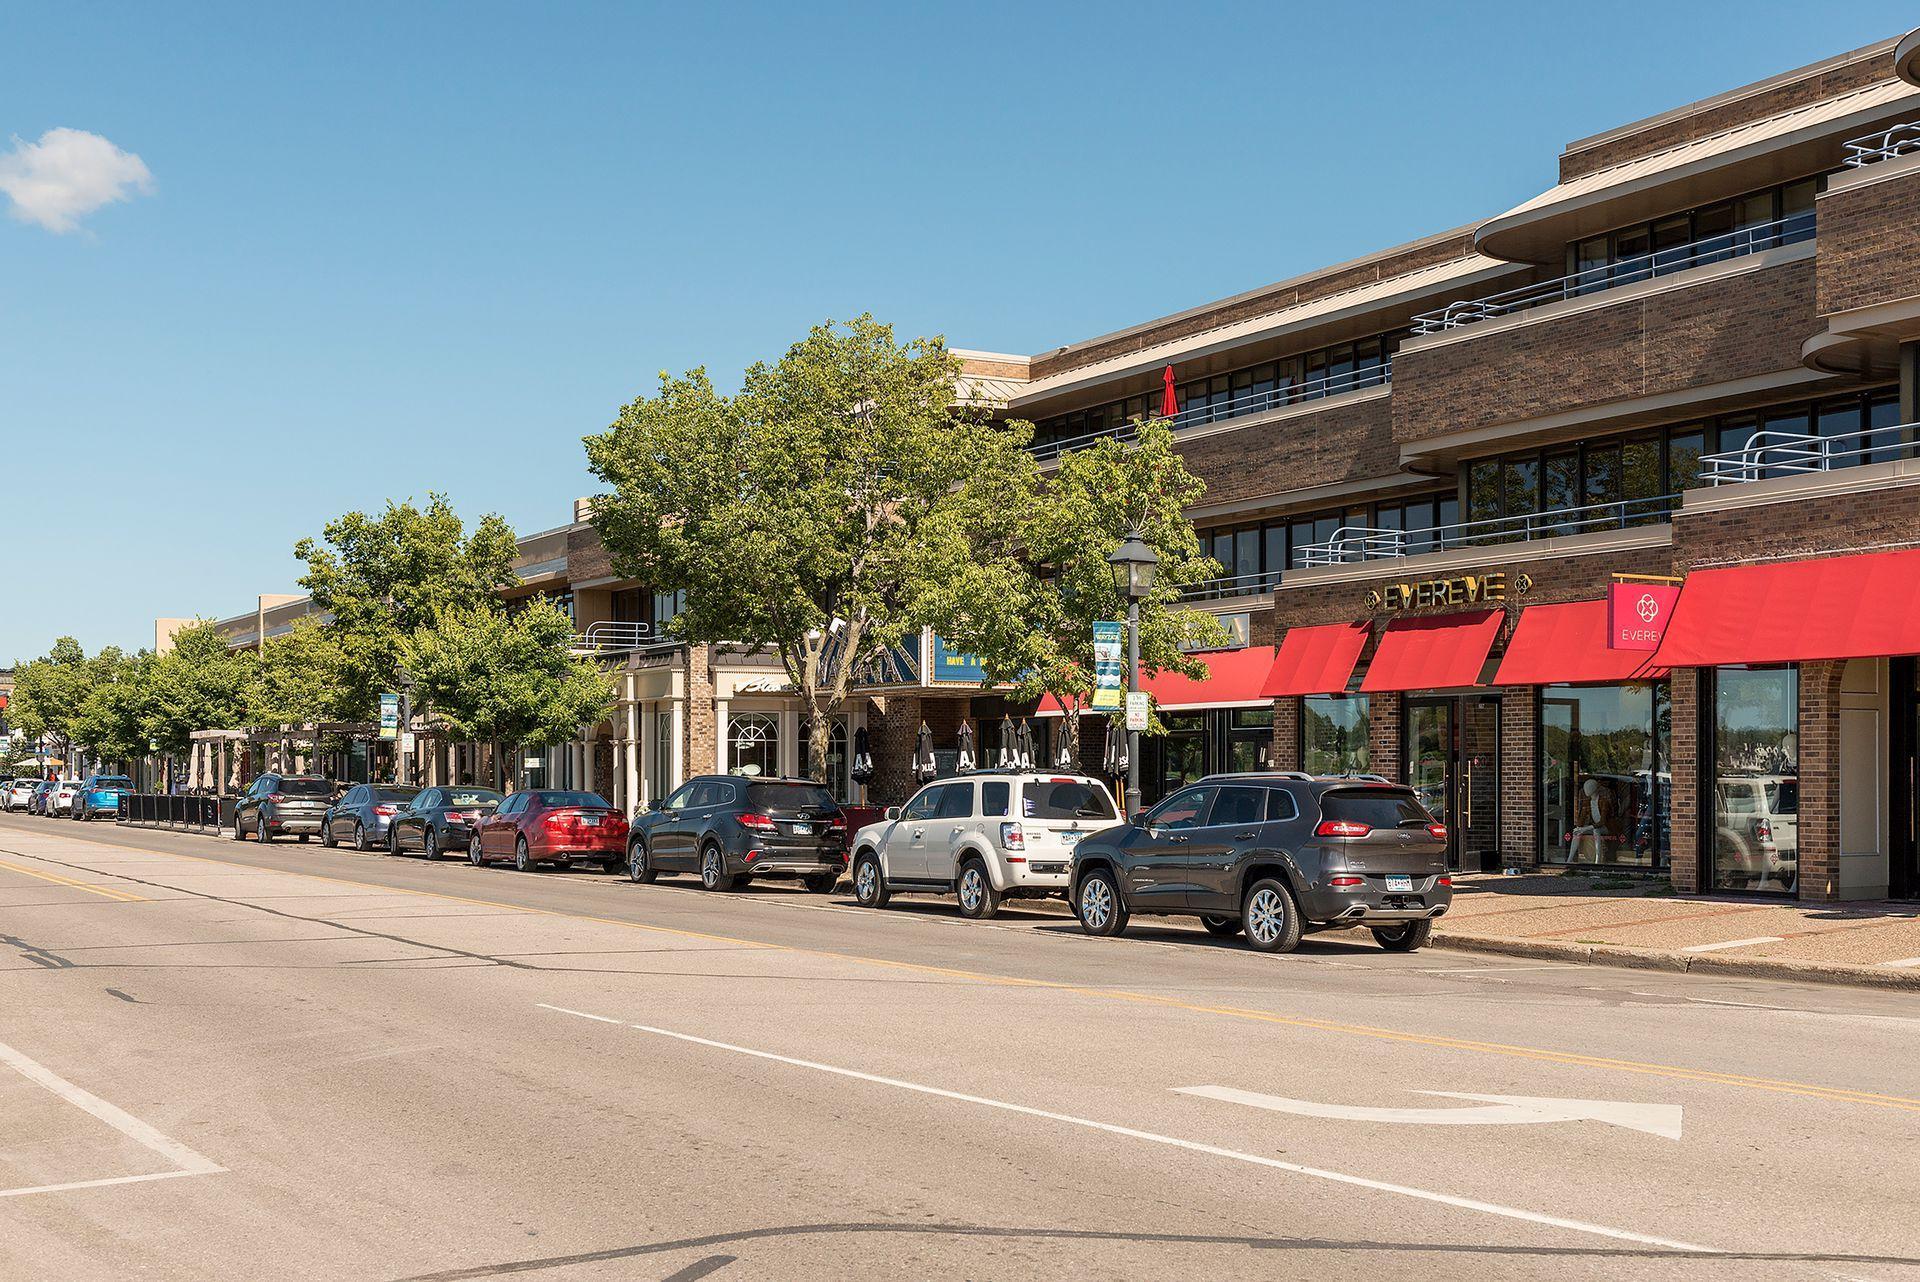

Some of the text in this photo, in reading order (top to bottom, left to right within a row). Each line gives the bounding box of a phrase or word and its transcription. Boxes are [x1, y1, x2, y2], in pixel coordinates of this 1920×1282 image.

[1384, 572, 1505, 610] EVEREVE
[946, 656, 964, 666] HAVE
[970, 656, 976, 666] A
